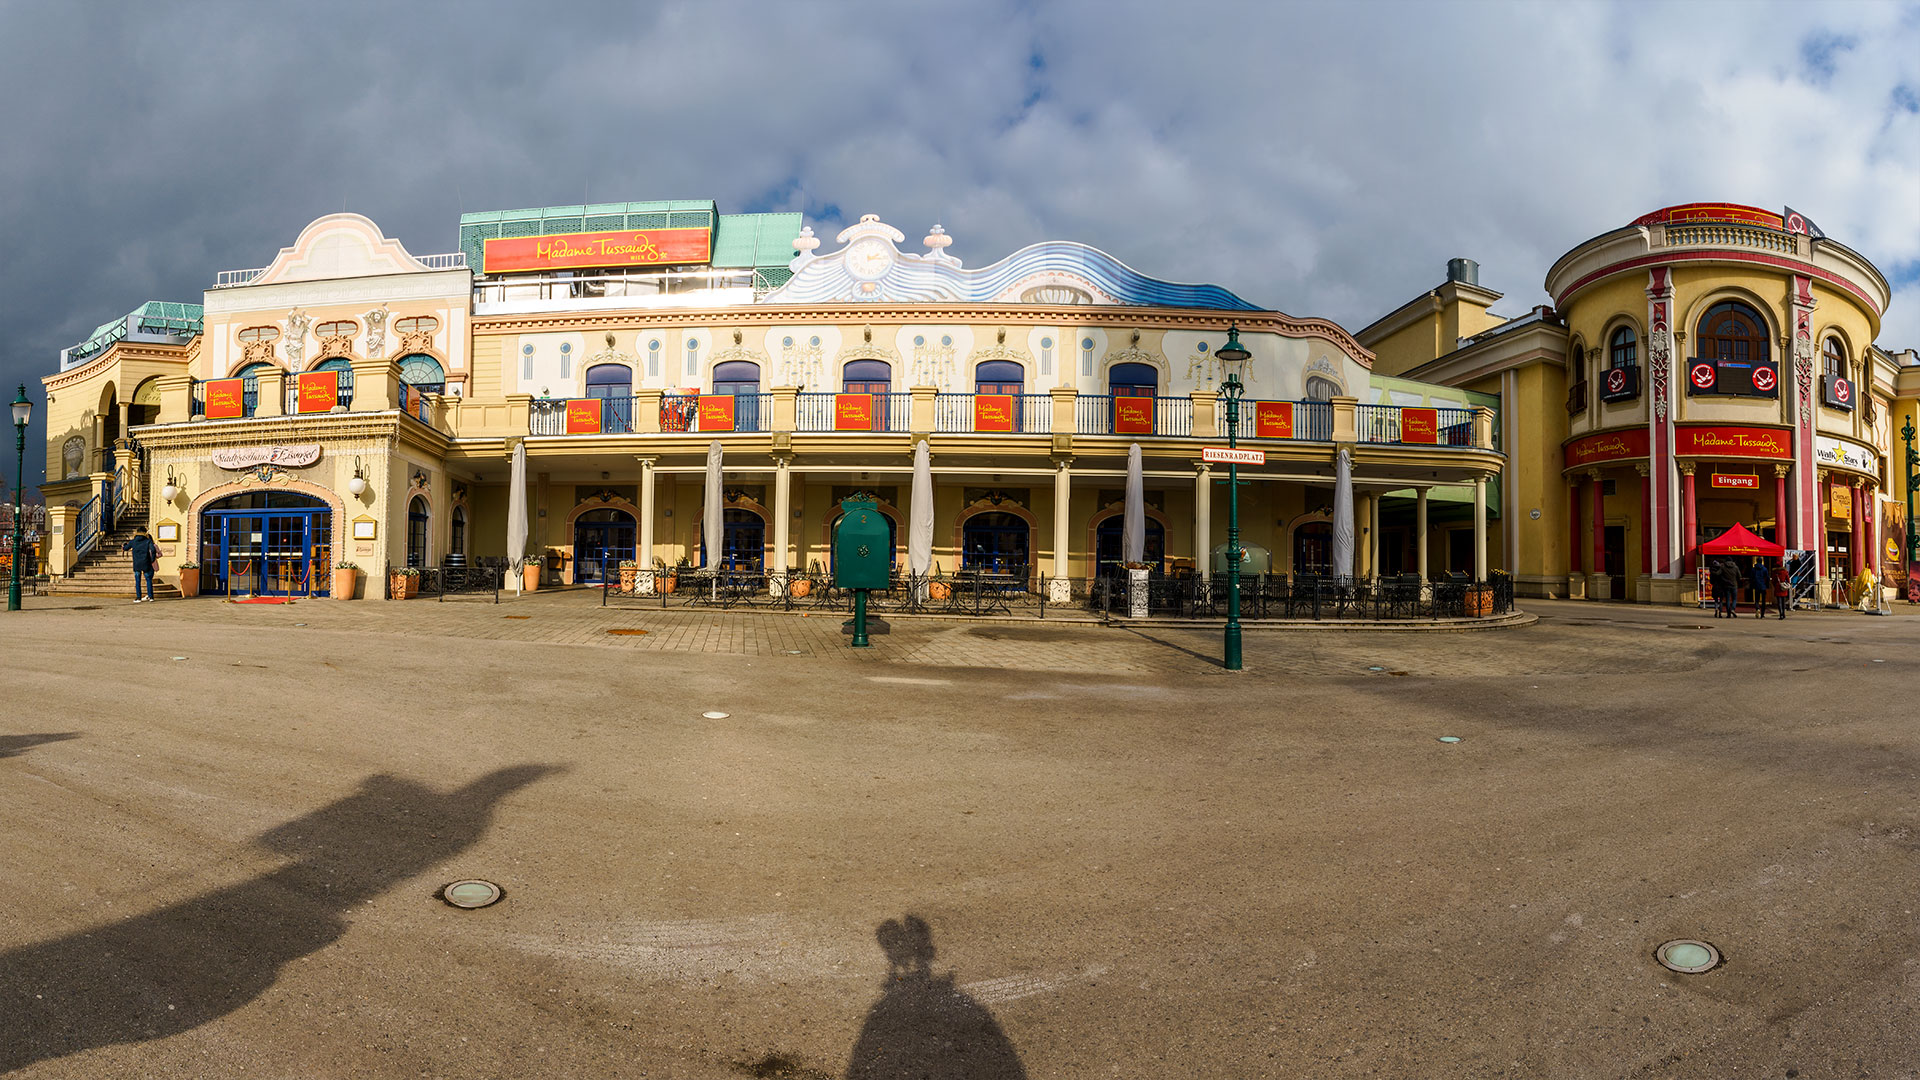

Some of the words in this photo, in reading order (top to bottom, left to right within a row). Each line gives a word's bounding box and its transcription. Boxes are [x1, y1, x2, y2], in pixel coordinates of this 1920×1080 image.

[536, 239, 597, 260] Madame
[592, 234, 659, 260] Tussauds
[1594, 437, 1626, 455] Tussauds
[1694, 432, 1737, 447] Madame
[1733, 434, 1781, 454] Tussauds
[1204, 451, 1263, 461] RIESENRADPLATZ
[1817, 449, 1837, 460] Walk
[1844, 455, 1859, 465] Stars
[1718, 476, 1753, 486] Eingang
[861, 514, 868, 524] 2
